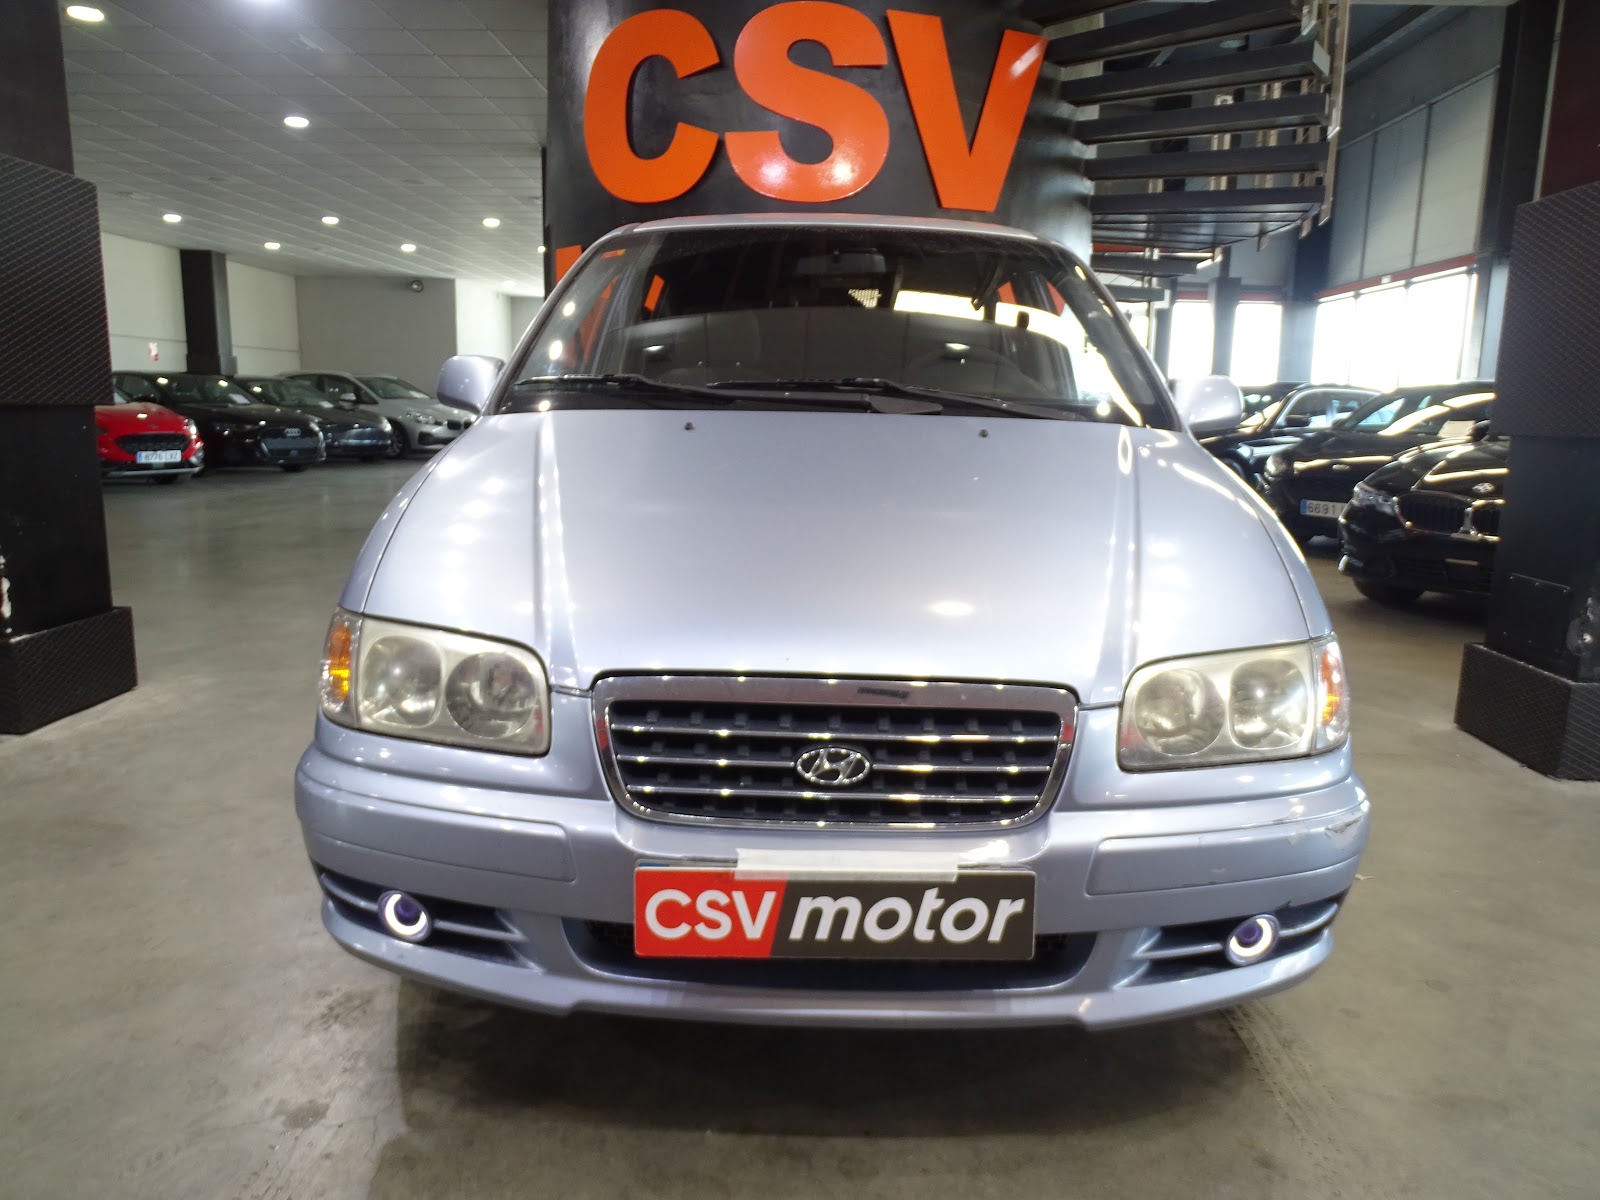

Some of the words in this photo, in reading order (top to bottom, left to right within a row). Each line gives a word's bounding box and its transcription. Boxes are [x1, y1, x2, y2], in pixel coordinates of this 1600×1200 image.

[584, 1, 1048, 212] CSV
[645, 889, 777, 940] CSV
[788, 887, 1025, 943] motor
